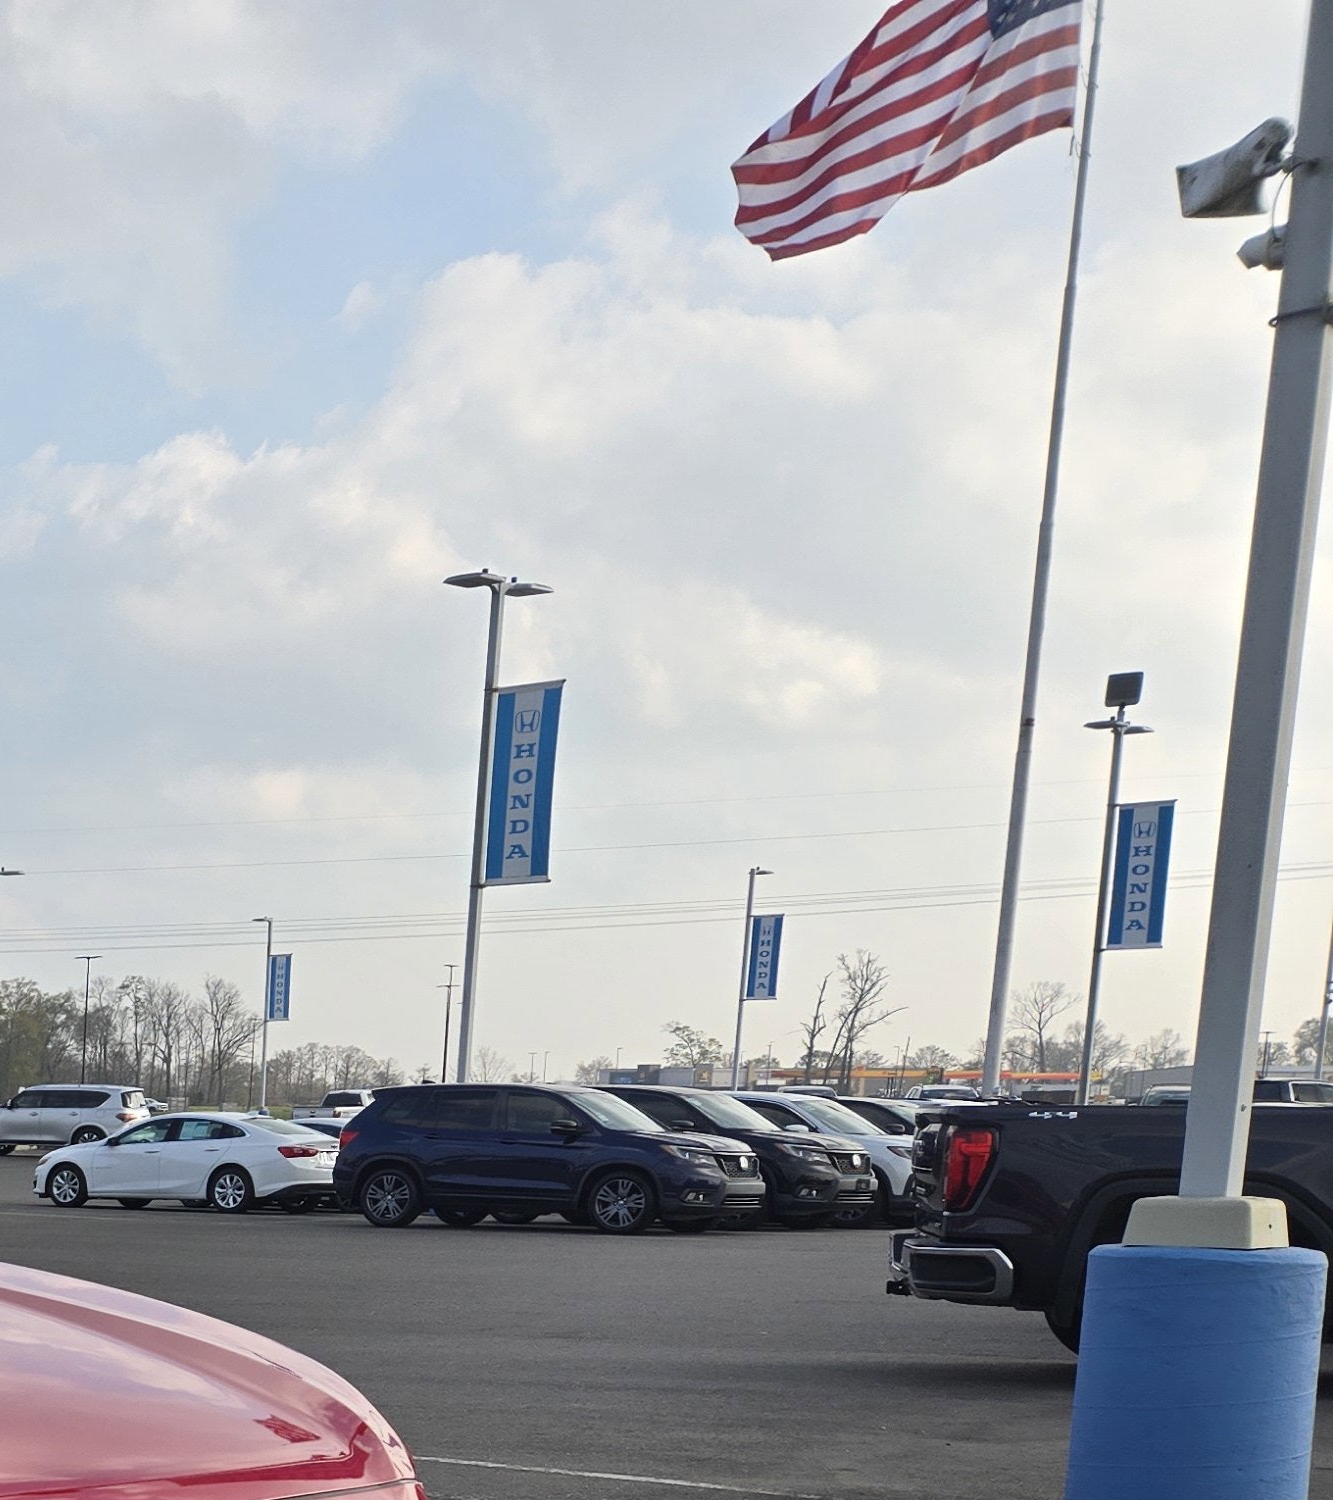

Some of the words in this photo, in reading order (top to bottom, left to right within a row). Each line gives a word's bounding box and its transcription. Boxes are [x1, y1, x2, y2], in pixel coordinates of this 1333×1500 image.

[505, 742, 537, 860] HONDA
[1124, 844, 1154, 931] HONDA
[756, 939, 772, 990] HONDA
